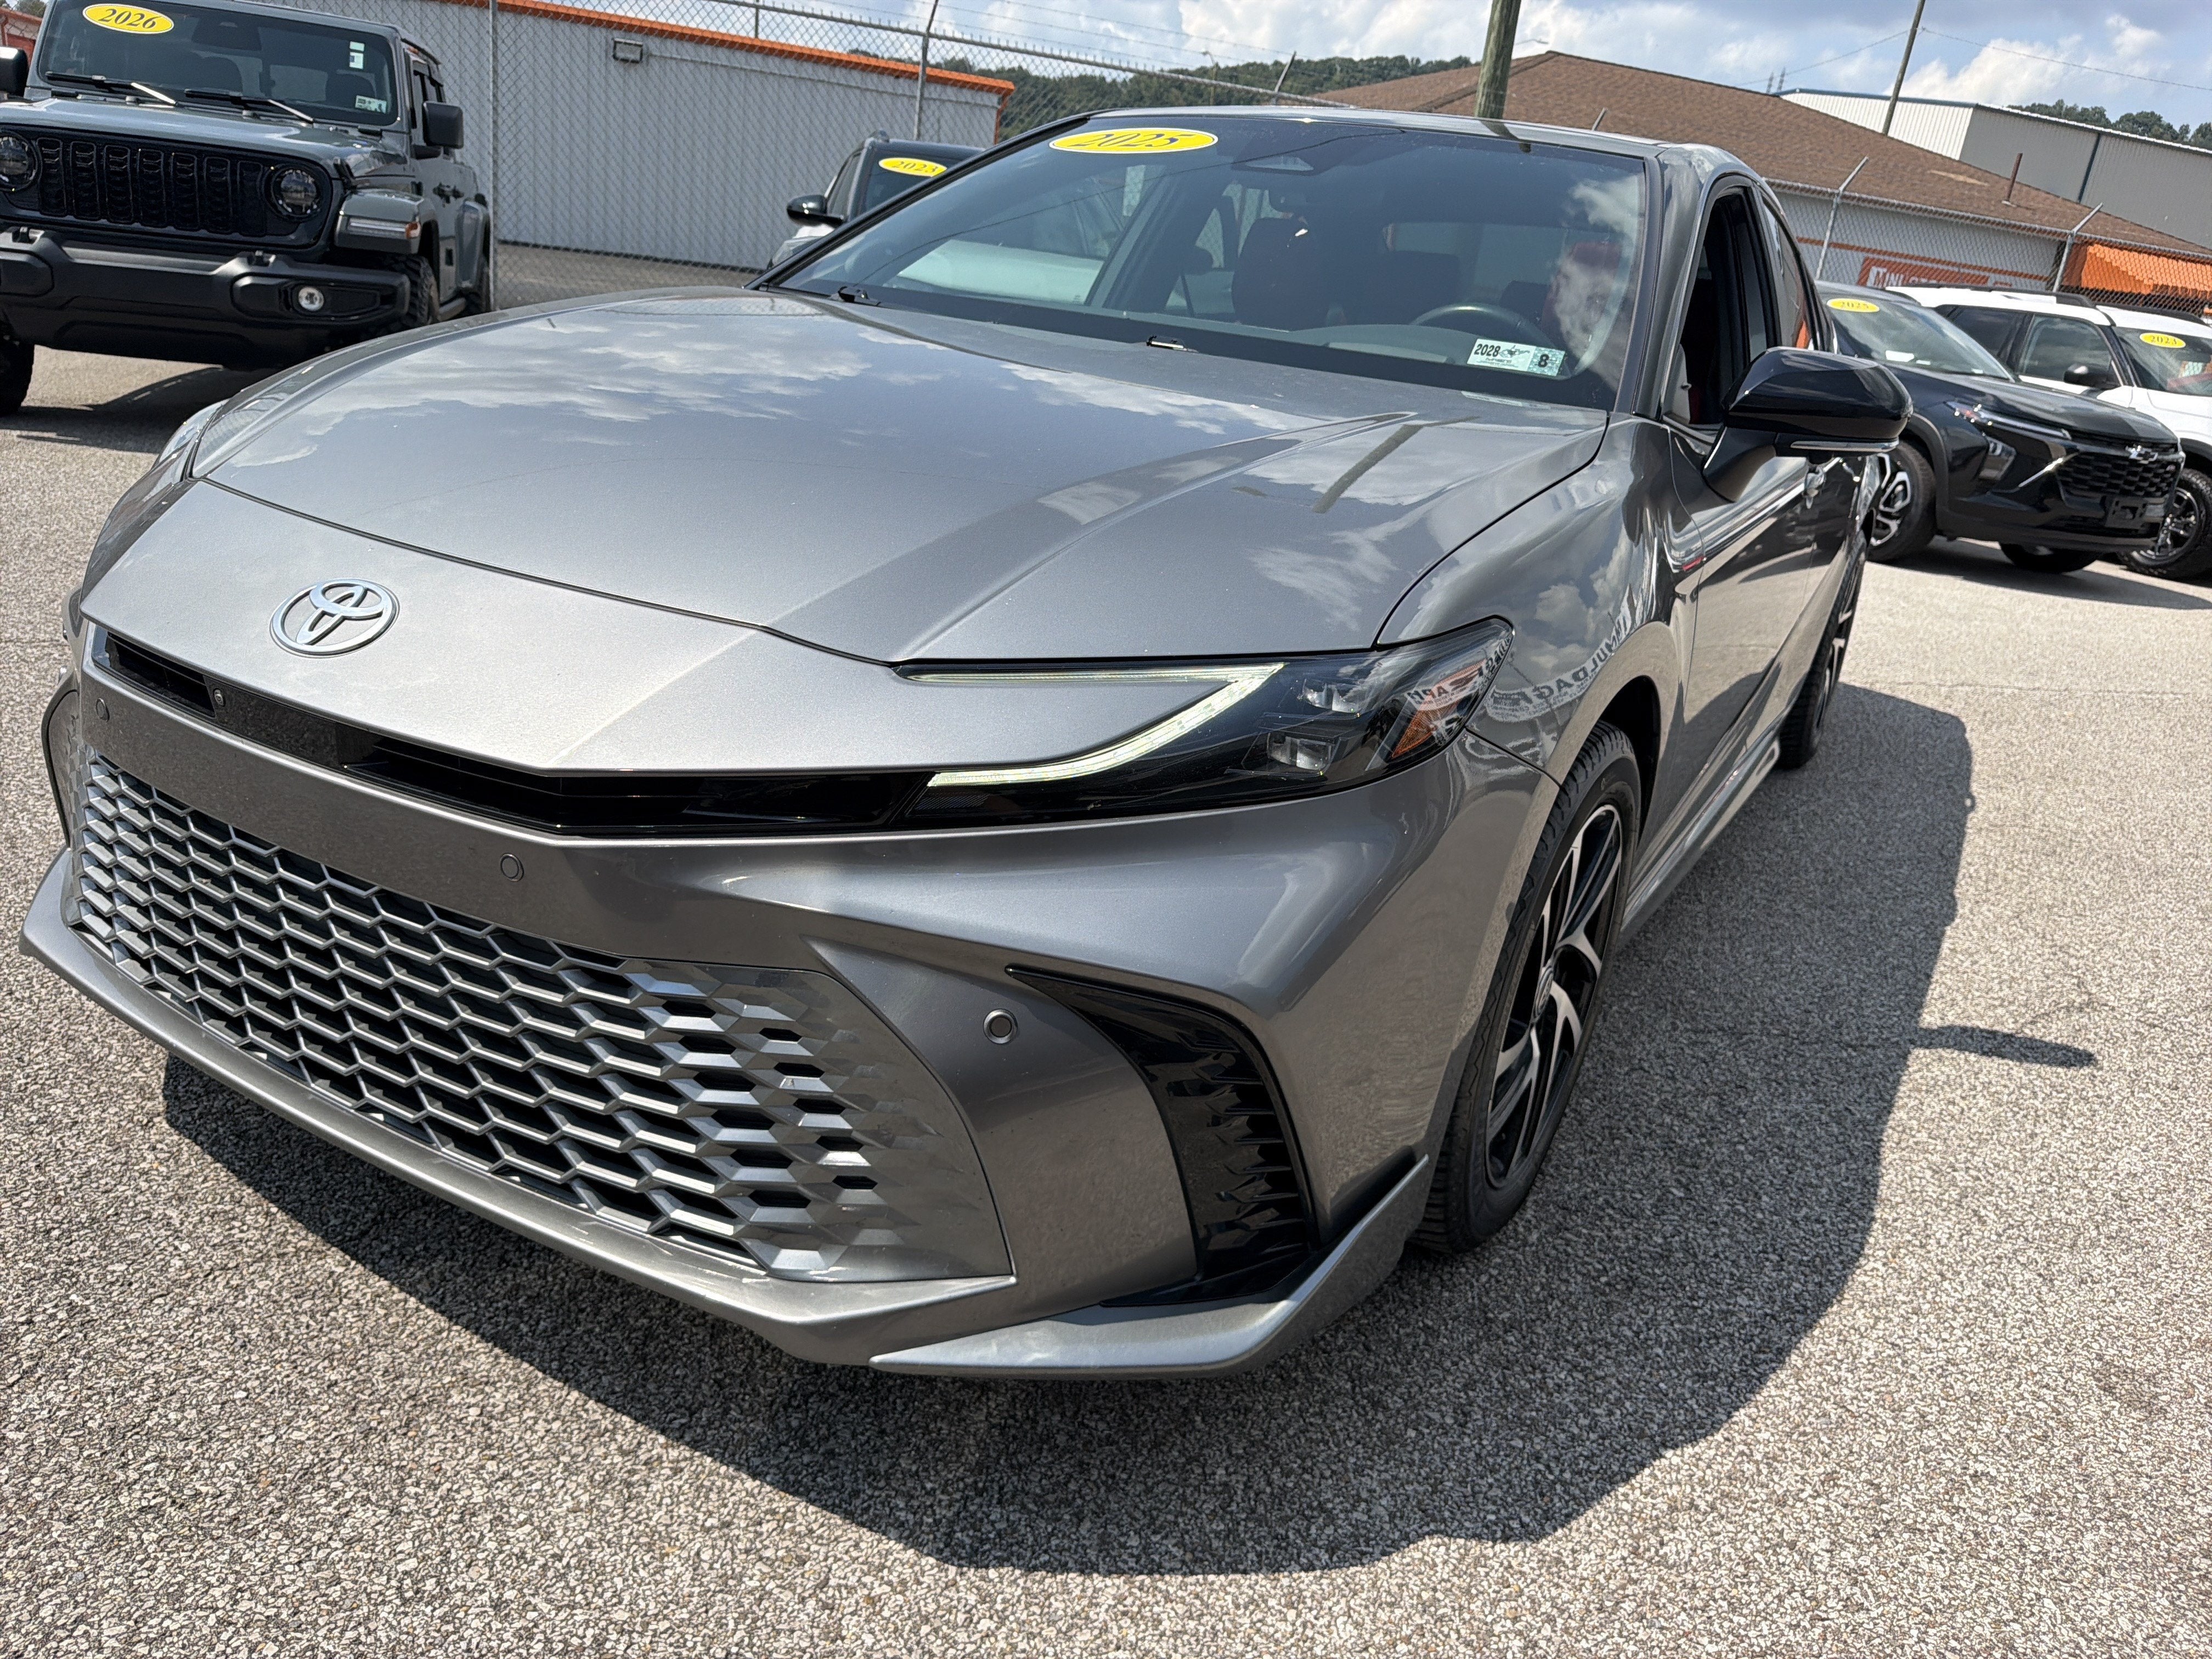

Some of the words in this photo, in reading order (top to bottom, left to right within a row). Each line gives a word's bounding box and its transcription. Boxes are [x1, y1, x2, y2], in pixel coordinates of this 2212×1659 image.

[98, 8, 161, 29] 2026
[1069, 133, 1194, 148] 2025
[891, 161, 938, 173] 2023
[1474, 343, 1501, 358] 2028
[1538, 353, 1550, 368] 8
